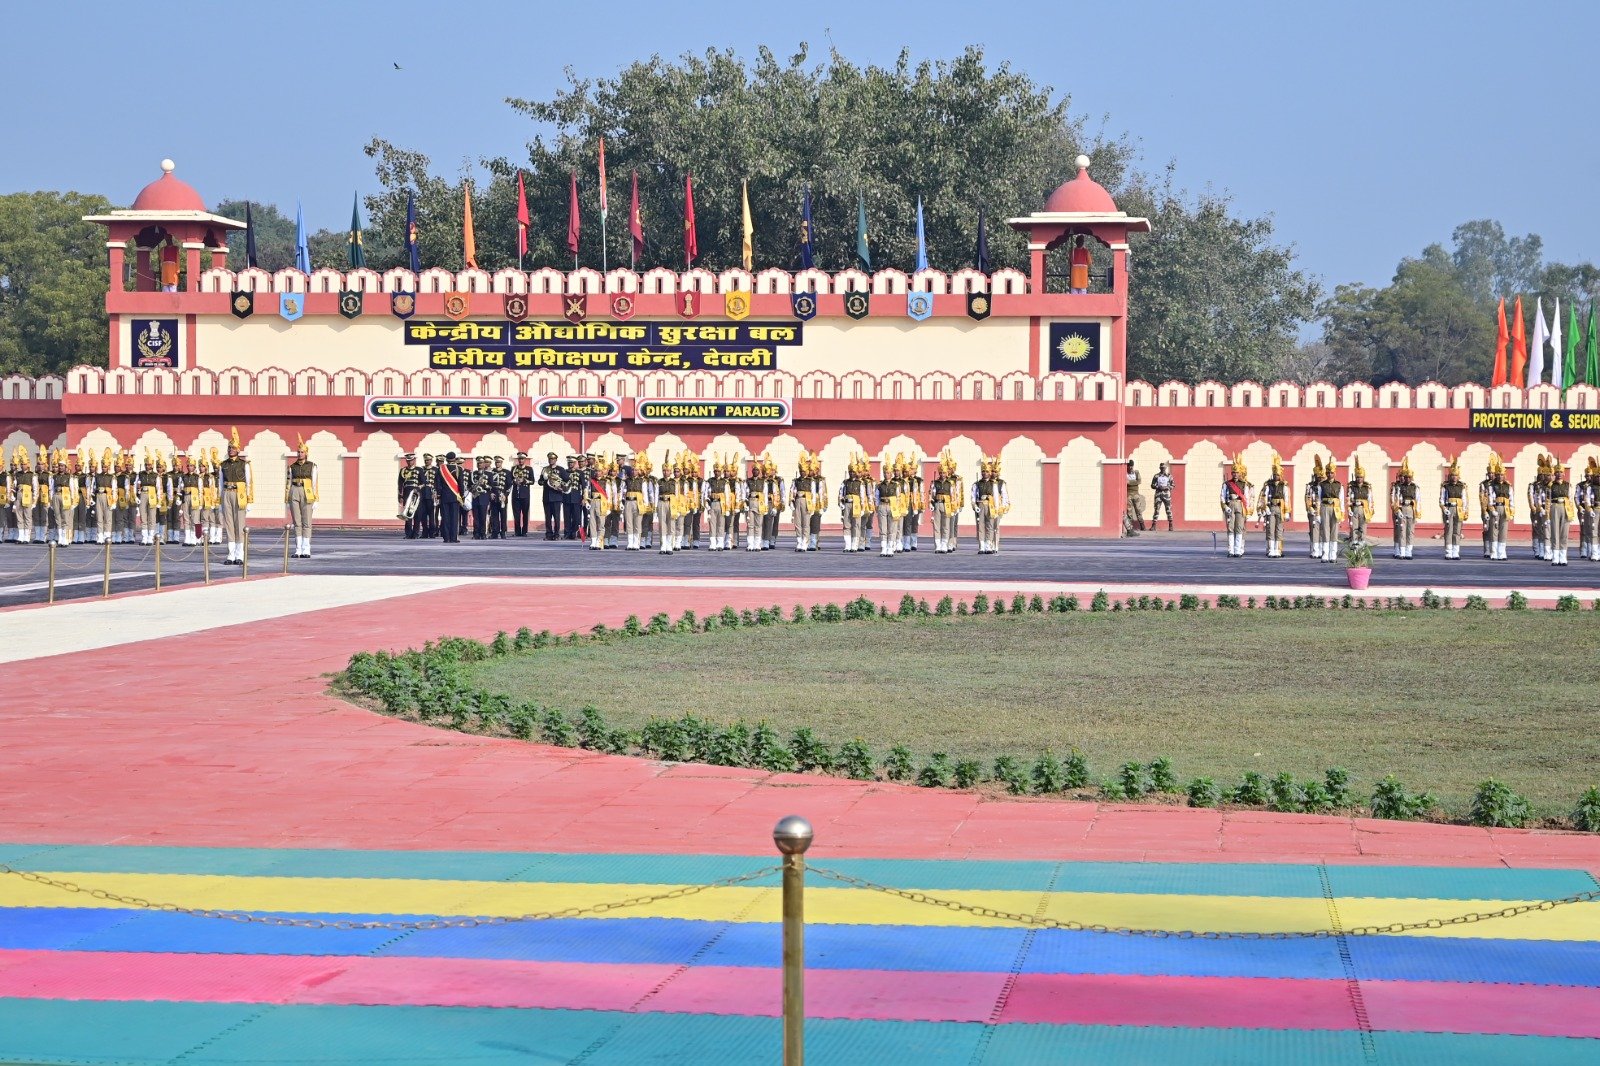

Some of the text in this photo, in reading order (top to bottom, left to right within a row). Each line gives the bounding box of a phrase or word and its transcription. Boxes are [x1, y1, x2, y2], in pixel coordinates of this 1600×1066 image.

[410, 322, 797, 345] केन्द्रीय औद्योगिक सुरक्षा बल
[432, 347, 773, 369] क्षेत्रीय प्रशिक्षण केन्द्र, देवली
[377, 403, 507, 416] दीक्षांत परेड
[646, 405, 780, 417] DIKSHANT PARADE
[1472, 412, 1542, 429] PROTECTION
[1550, 413, 1564, 429] &
